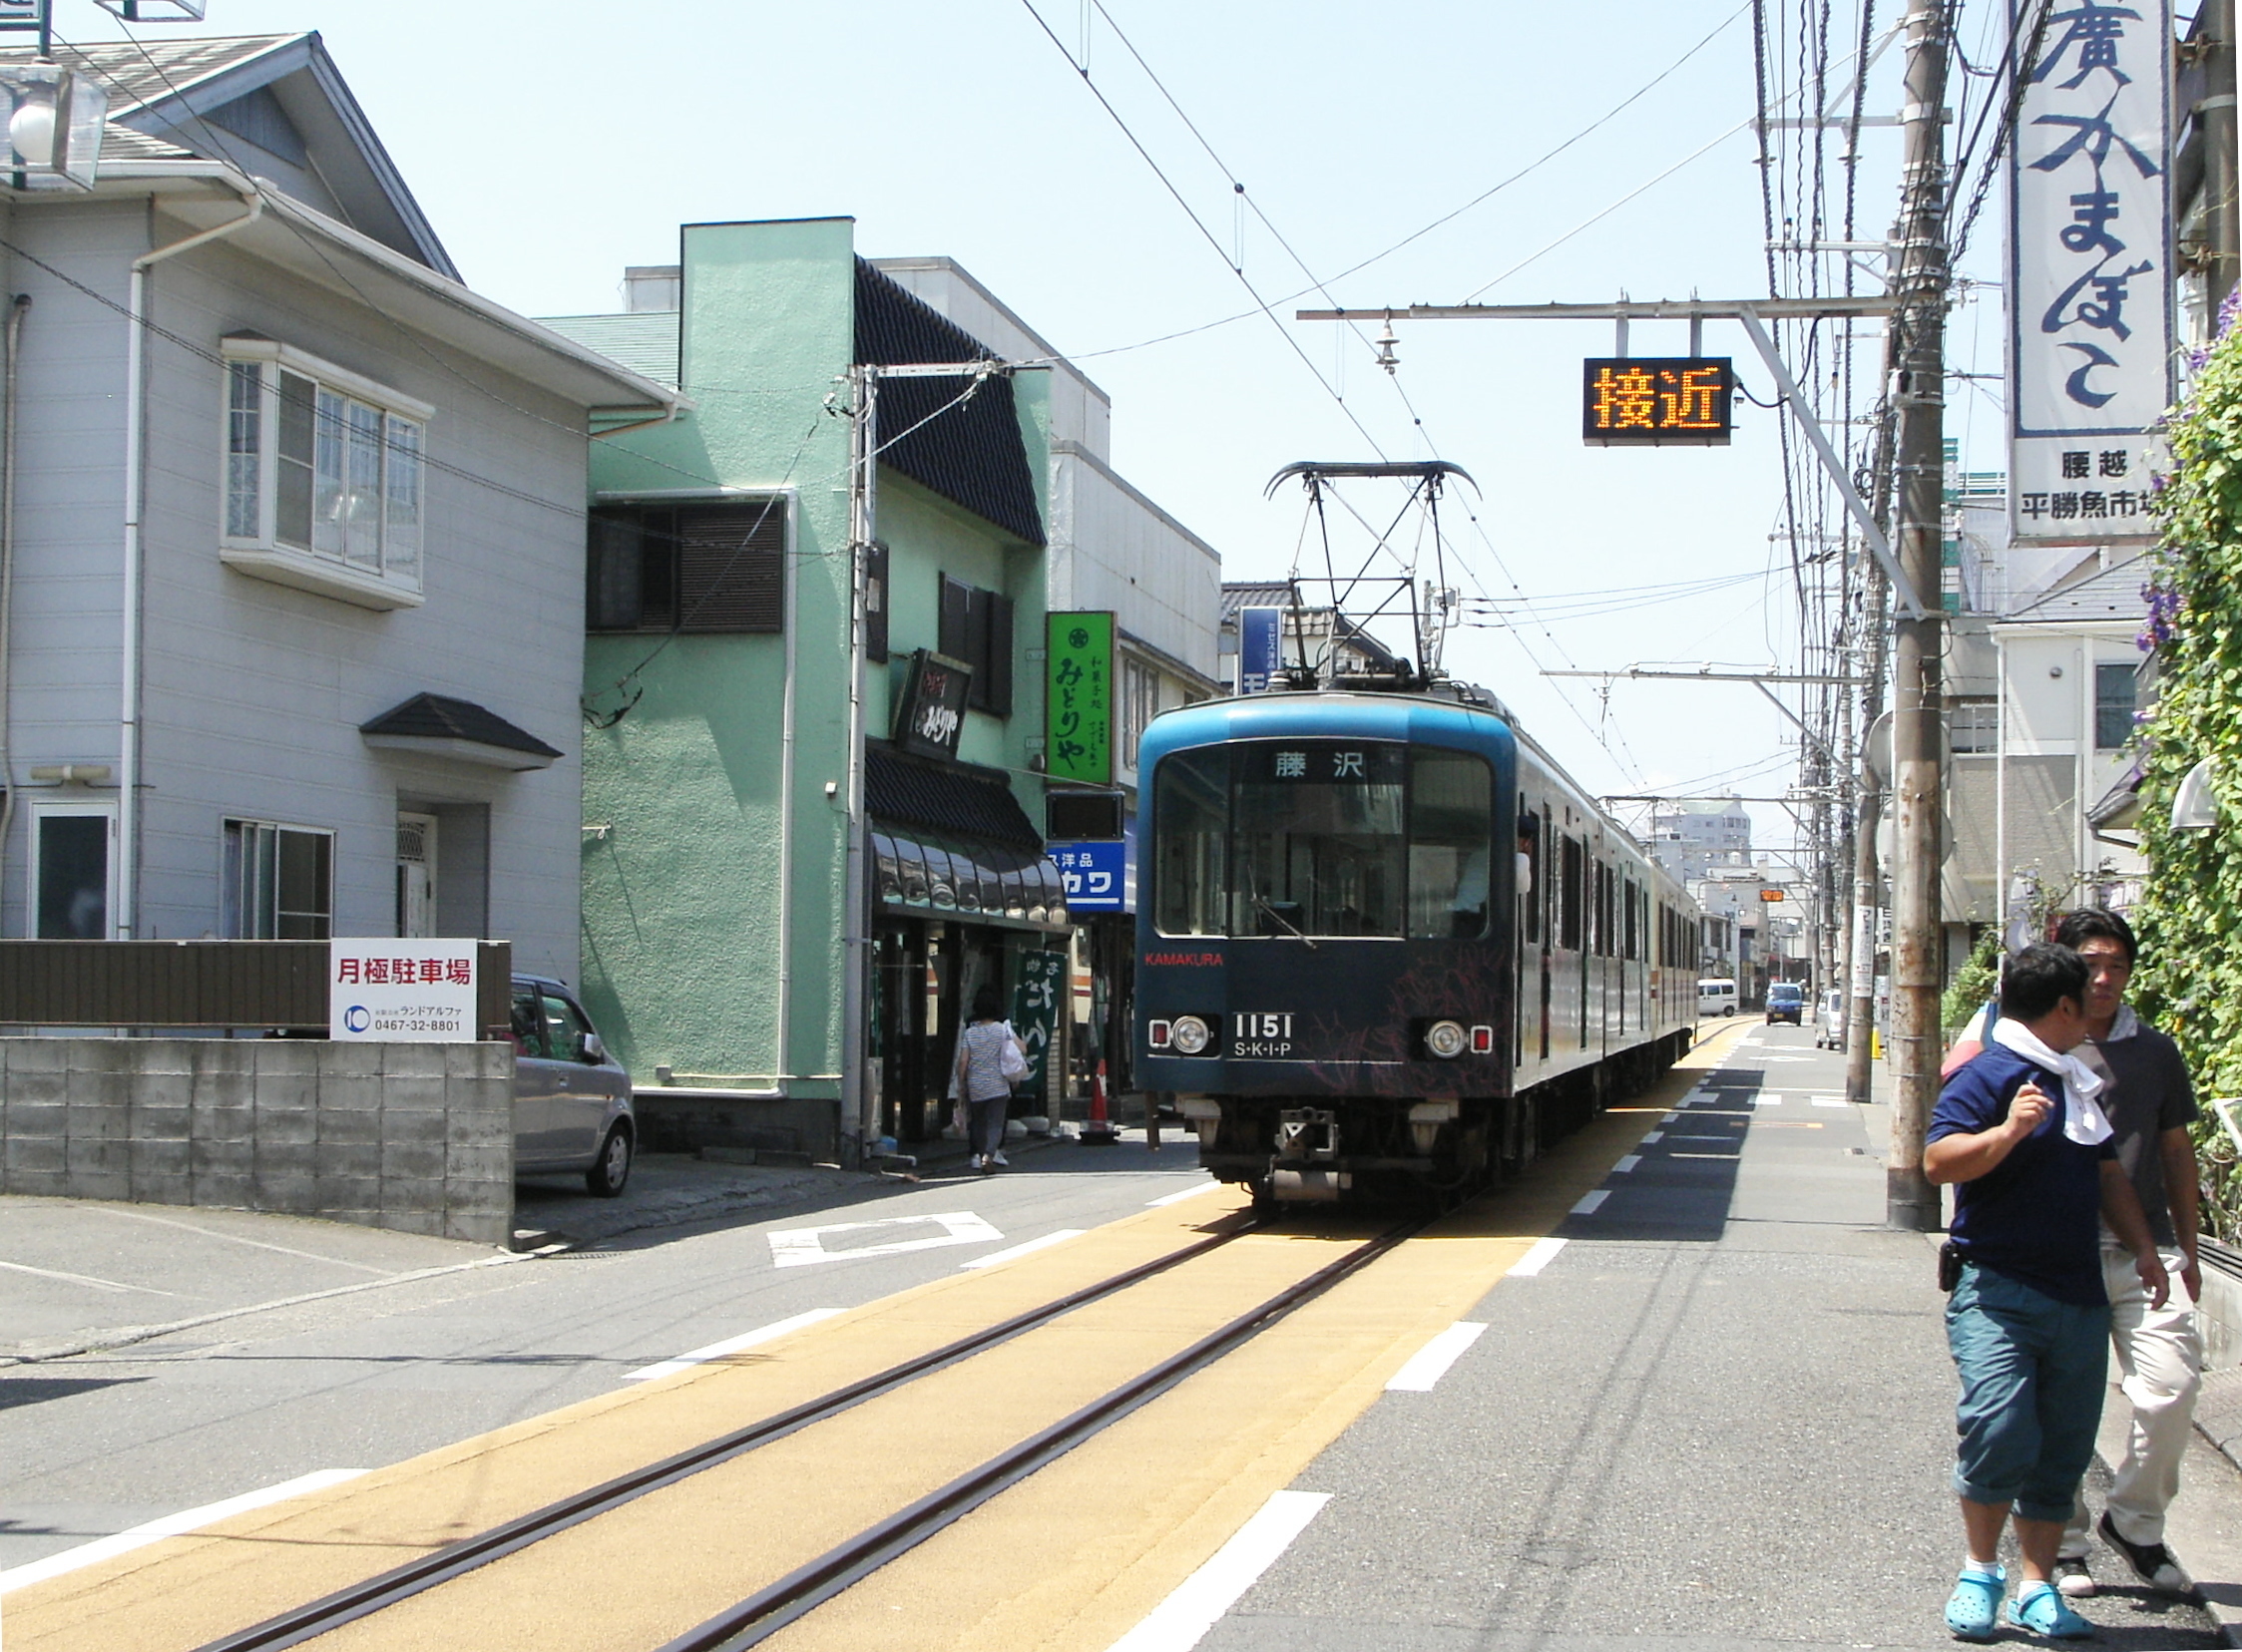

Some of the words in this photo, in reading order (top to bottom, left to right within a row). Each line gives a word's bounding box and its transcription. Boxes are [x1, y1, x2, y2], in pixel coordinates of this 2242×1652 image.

[1592, 366, 1722, 430] 接近
[2061, 450, 2127, 479] 腰越
[1056, 657, 1086, 770] みどりや
[1276, 751, 1363, 777] 藤沢
[337, 958, 472, 986] 月極駐車場
[1144, 953, 1223, 967] KAMAKURA
[375, 1020, 460, 1032] 0467-32-8801
[1236, 1014, 1291, 1038] 1151
